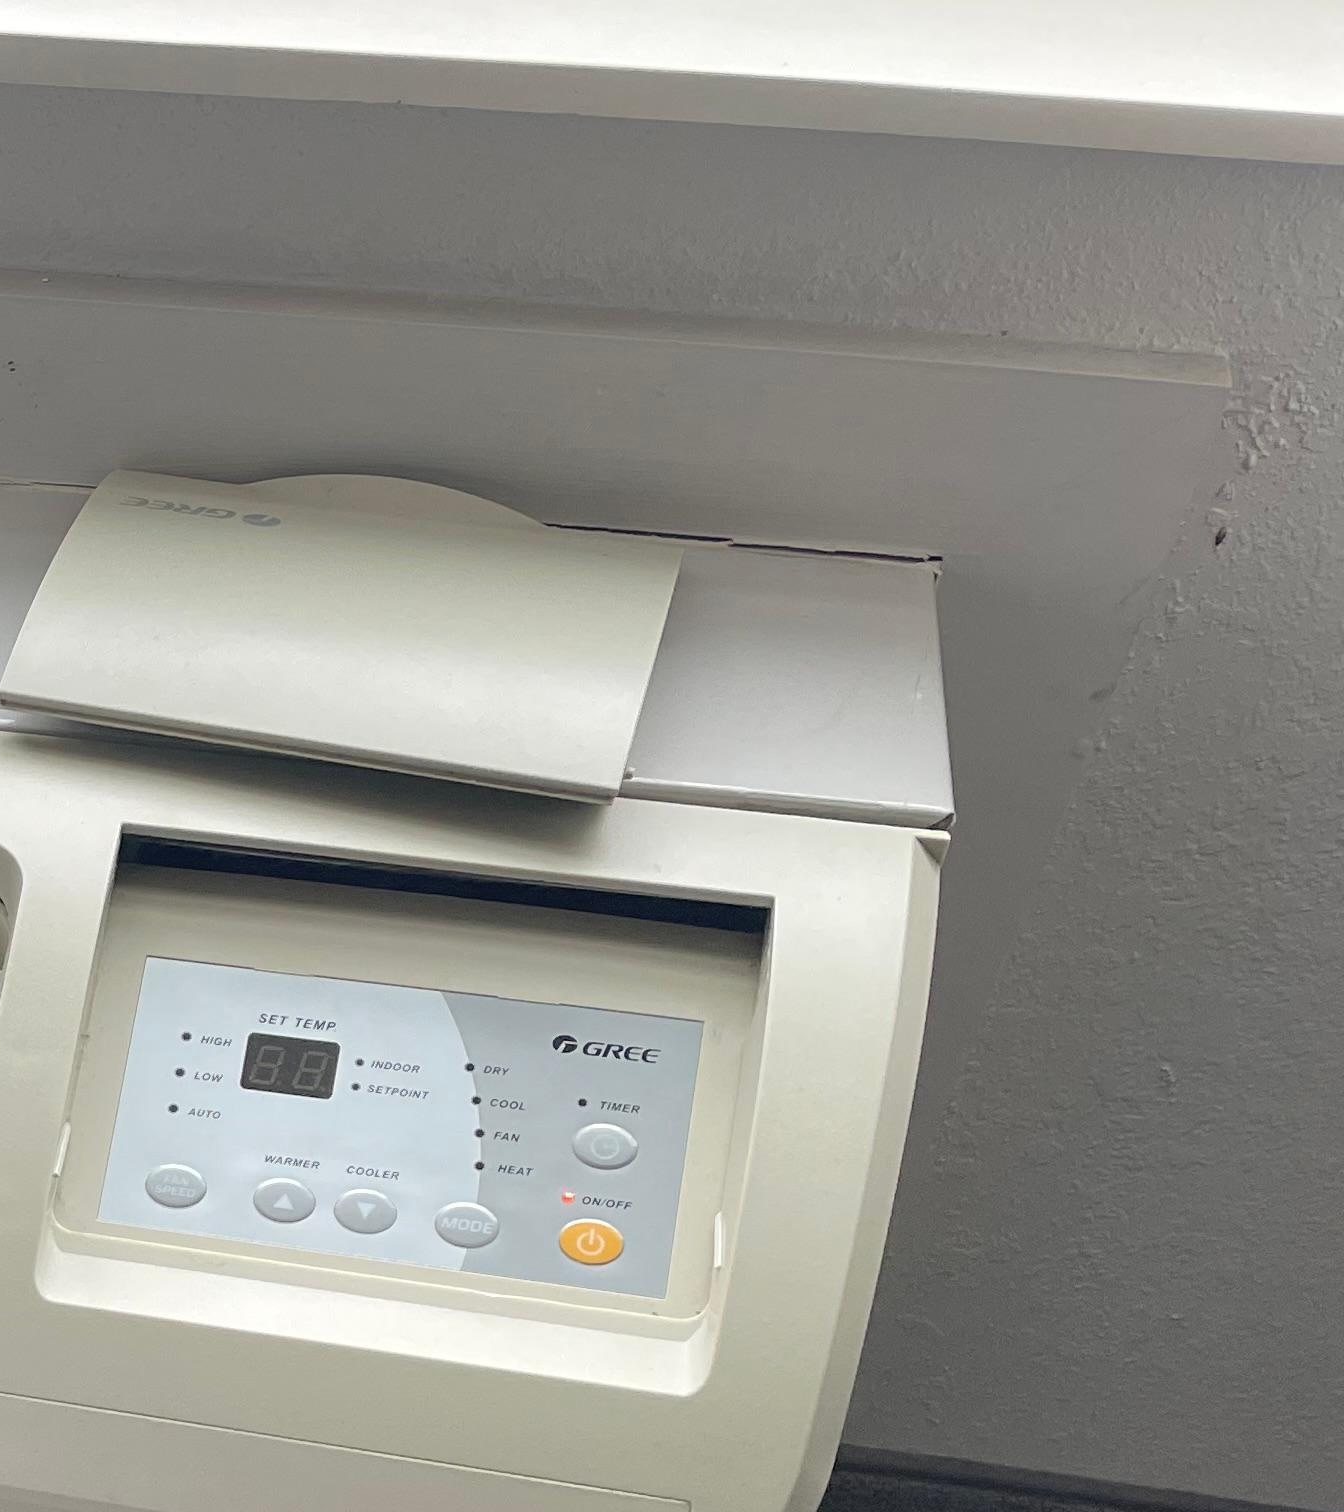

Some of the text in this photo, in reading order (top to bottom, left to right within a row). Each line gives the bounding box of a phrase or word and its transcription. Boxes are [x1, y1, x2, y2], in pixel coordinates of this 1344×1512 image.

[119, 496, 237, 519] GREE
[258, 1013, 289, 1026] SET
[200, 1035, 233, 1048] HIGH
[582, 1041, 662, 1064] GREE
[370, 1060, 421, 1074] INDOOR
[483, 1065, 510, 1077] DRY
[193, 1071, 224, 1083] LOW
[367, 1084, 430, 1100] SETPOINT
[489, 1098, 526, 1111] COOL
[600, 1100, 641, 1114] TIMER
[187, 1107, 222, 1120] AUTO
[493, 1131, 520, 1143] FAN
[264, 1154, 321, 1170] WARMER
[346, 1165, 400, 1180] COOLER
[497, 1164, 534, 1177] HEAT
[154, 1184, 196, 1199] SPEED
[581, 1195, 633, 1211] ON/OFF
[441, 1216, 495, 1236] MODE
